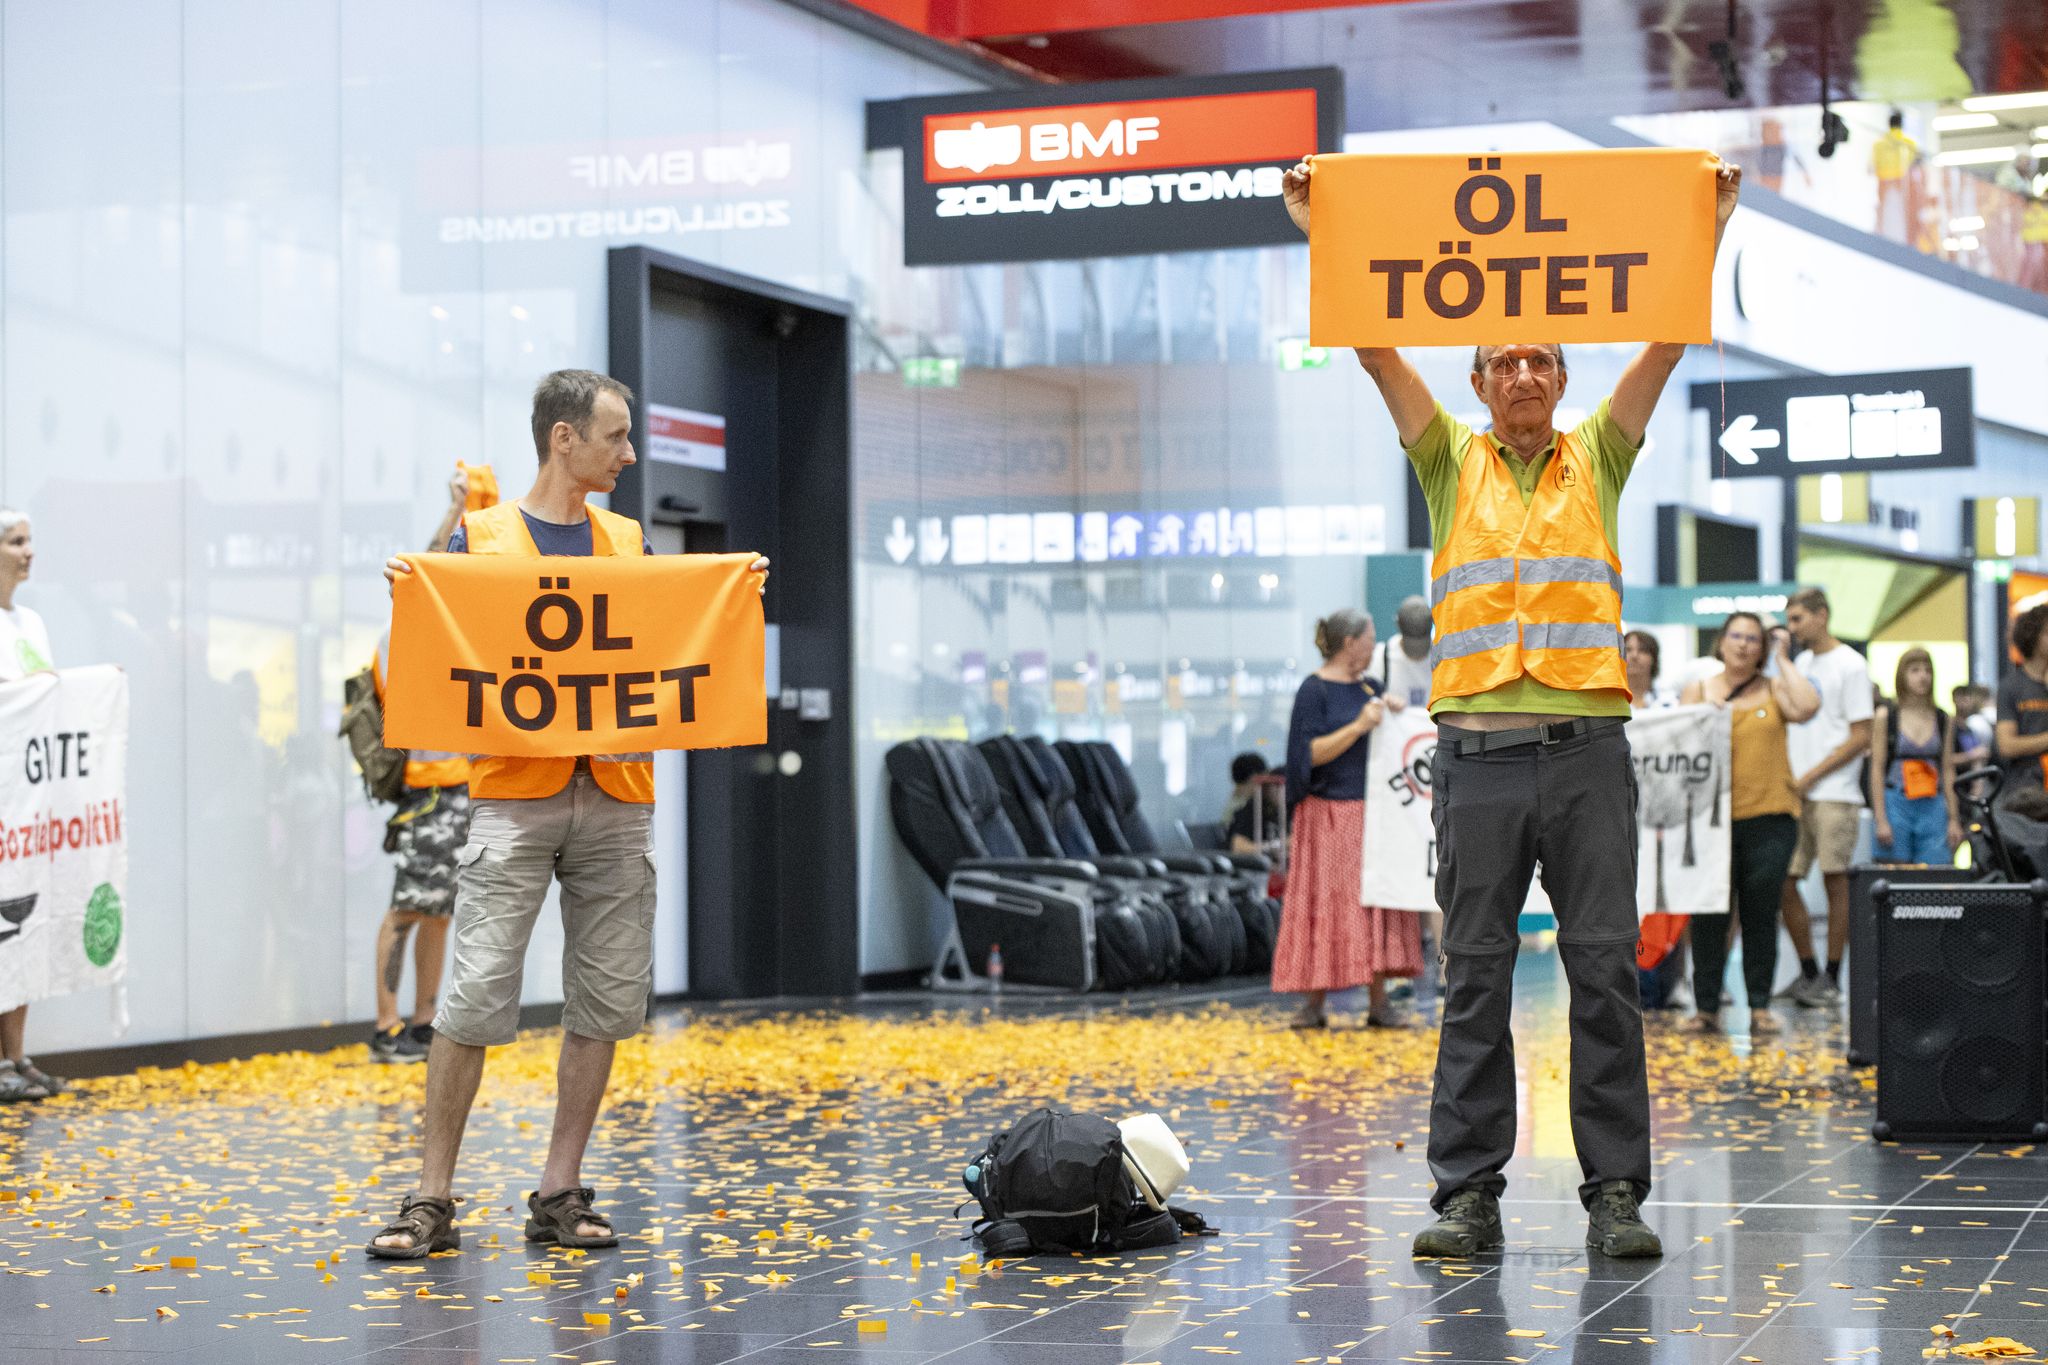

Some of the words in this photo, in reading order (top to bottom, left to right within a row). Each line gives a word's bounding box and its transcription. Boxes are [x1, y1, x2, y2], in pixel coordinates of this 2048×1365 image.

[1030, 117, 1160, 162] BMF
[936, 167, 1284, 218] ZOLL/CUSTOMS
[1454, 157, 1567, 235] ÖL
[1369, 241, 1648, 319] TÖTET
[525, 577, 633, 652] ÖL
[450, 656, 711, 731] TÖTET
